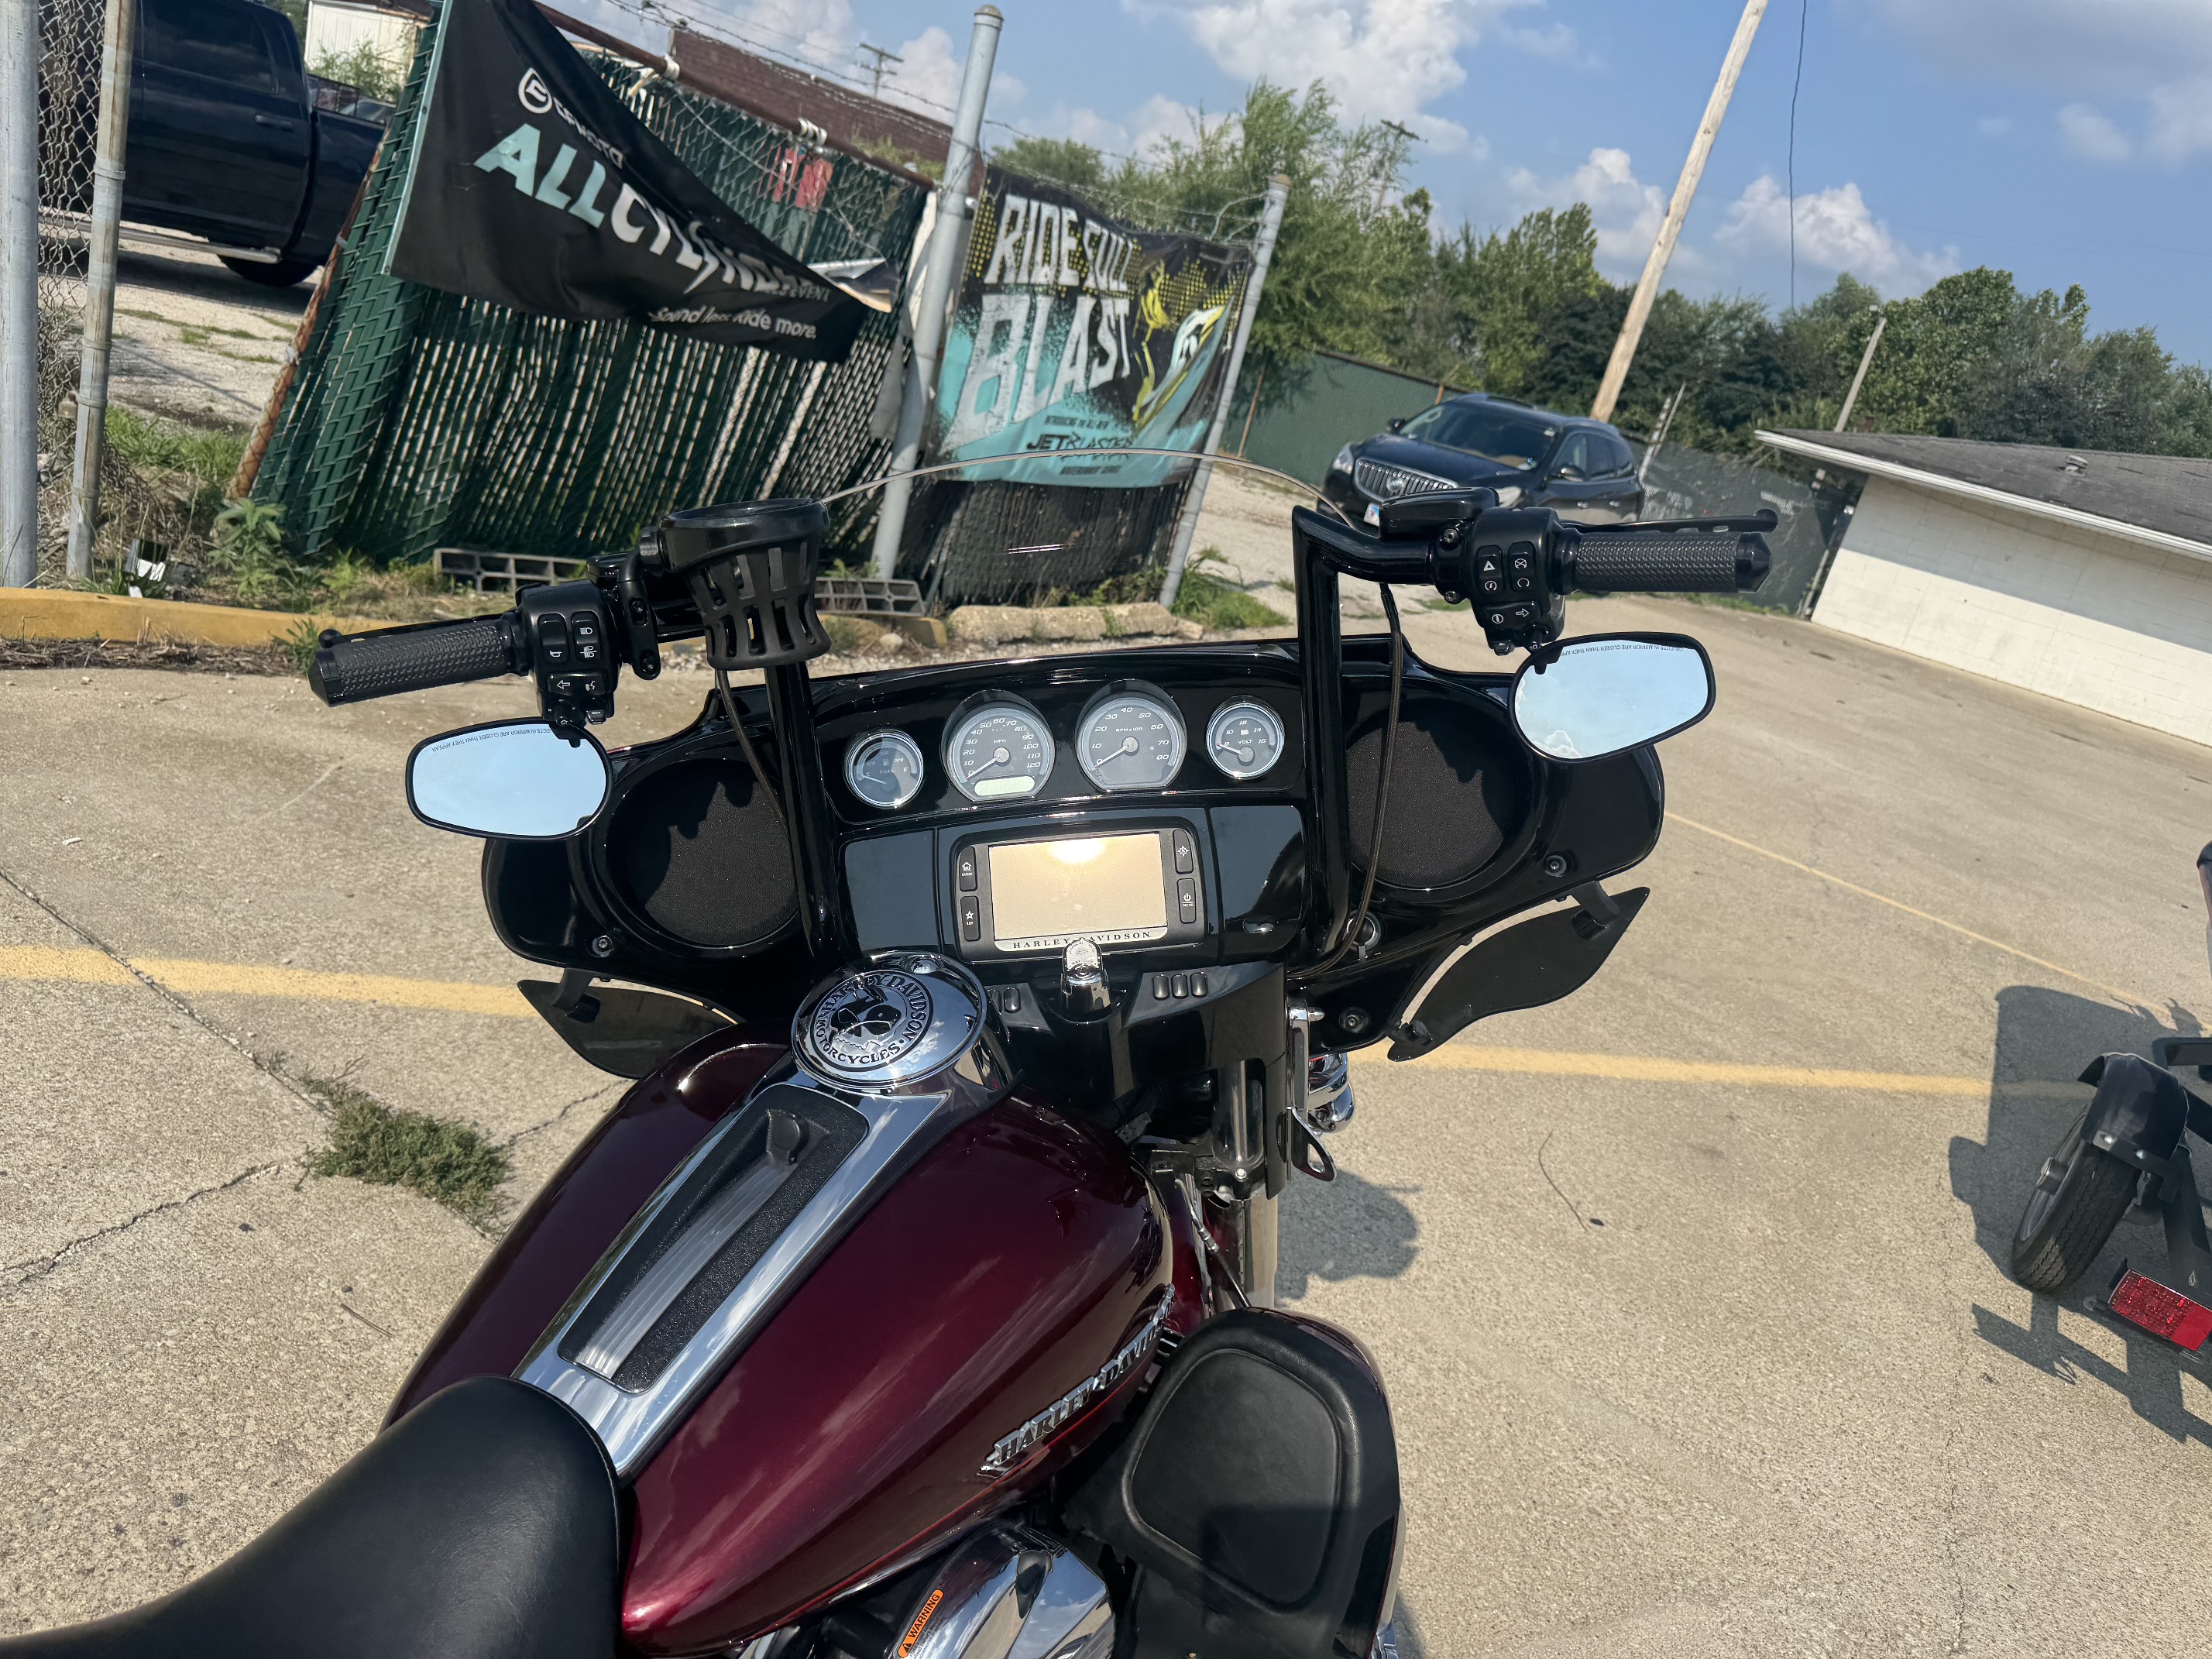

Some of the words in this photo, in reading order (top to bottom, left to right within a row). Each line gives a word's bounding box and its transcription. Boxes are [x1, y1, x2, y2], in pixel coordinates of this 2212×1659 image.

[984, 194, 1080, 287] RIDE
[938, 294, 1132, 455] BLAST
[908, 1594, 940, 1638] WARNING
